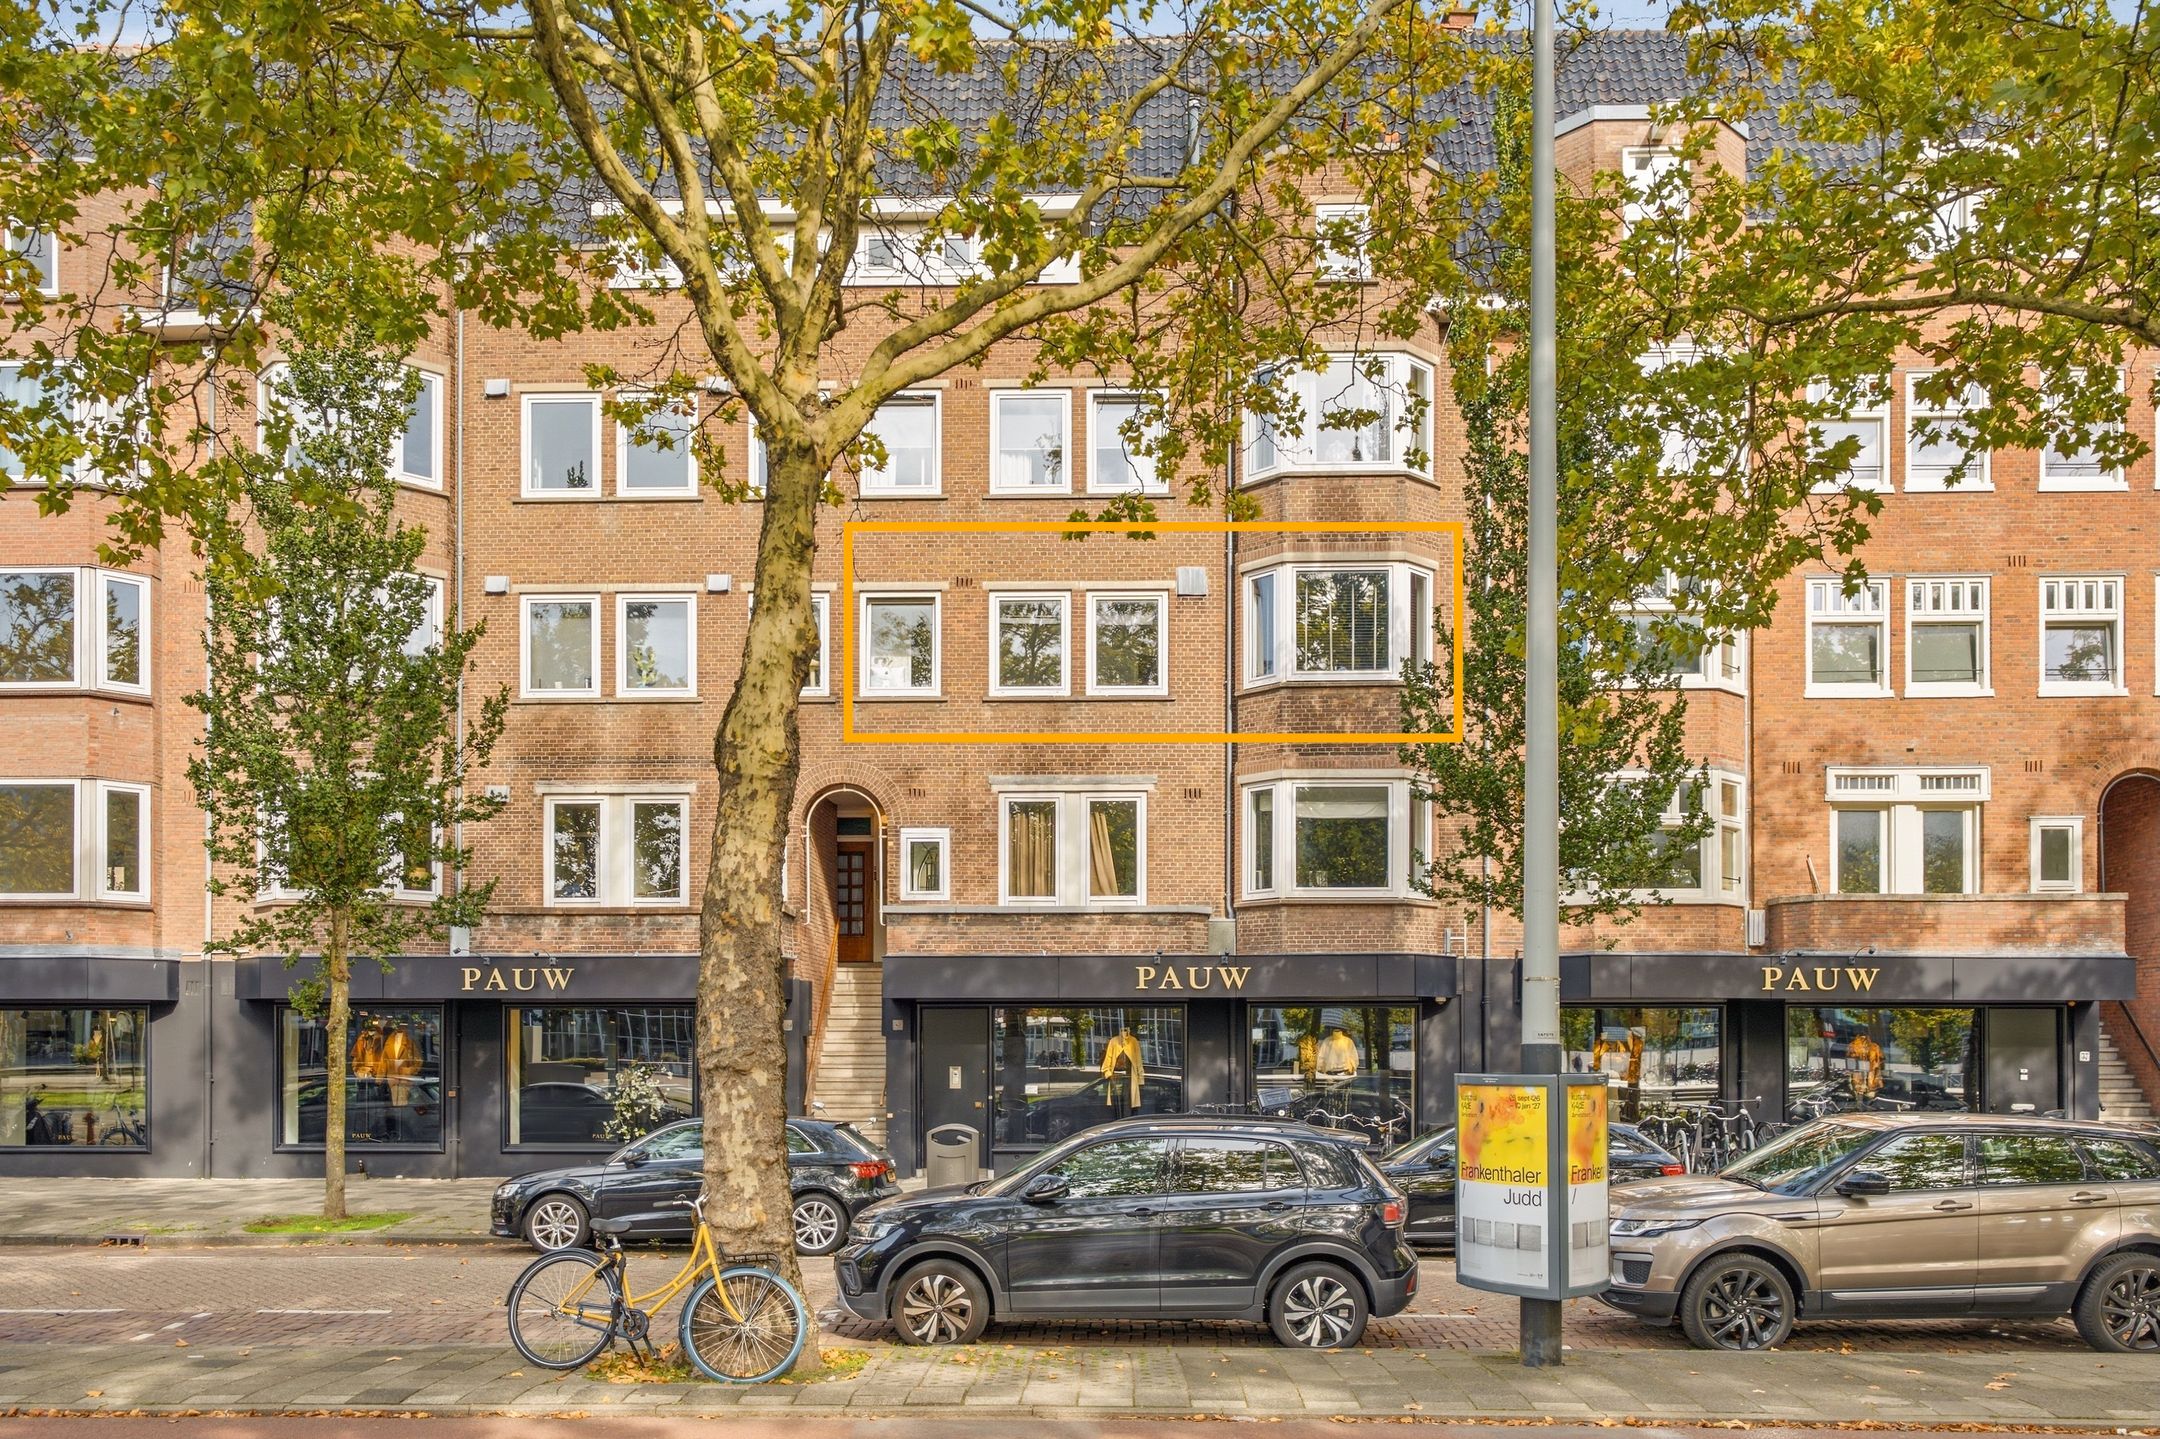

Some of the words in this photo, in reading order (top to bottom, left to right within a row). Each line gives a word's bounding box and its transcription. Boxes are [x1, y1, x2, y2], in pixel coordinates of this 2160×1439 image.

[460, 967, 575, 991] PAUW
[1136, 966, 1251, 990] PAUW
[1761, 967, 1881, 991] PAUW
[1461, 1162, 1541, 1183] Frankenthaler
[1503, 1188, 1542, 1206] Judd
